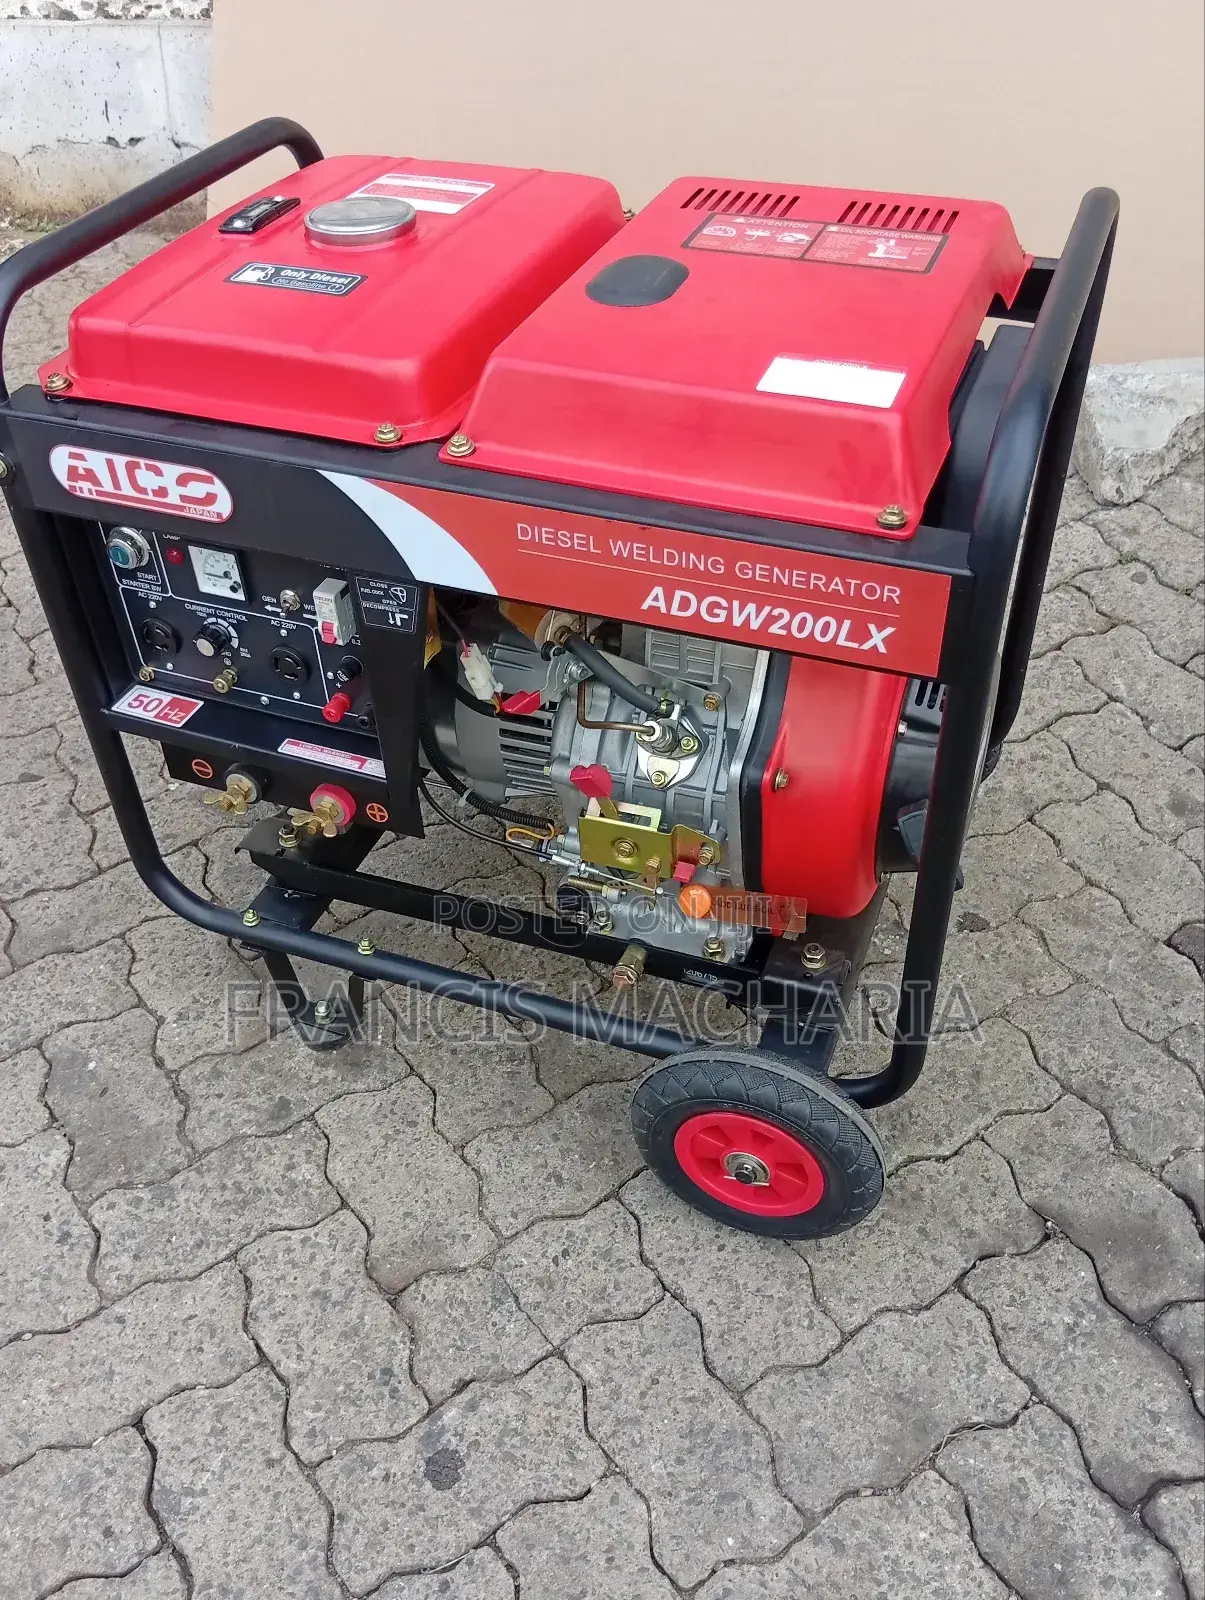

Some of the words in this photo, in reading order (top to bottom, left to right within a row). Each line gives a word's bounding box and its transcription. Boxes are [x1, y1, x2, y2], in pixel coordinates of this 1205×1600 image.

[746, 218, 810, 229] ATTENTION
[855, 229, 901, 239] SHORTAGE
[901, 233, 942, 243] WARNING
[280, 268, 310, 280] Only
[310, 271, 352, 285] Diesel
[290, 279, 327, 289] Gasoline
[183, 506, 218, 518] JAPAN
[517, 523, 602, 554] DIESEL
[609, 538, 726, 574] WELDING
[734, 561, 902, 605] GENERATOR
[136, 572, 157, 582] START
[121, 578, 150, 590] STARTER
[261, 595, 277, 604] GEN
[184, 603, 215, 615] CURRENT
[216, 609, 248, 622] CONTROL
[270, 619, 281, 627] AC
[281, 621, 297, 630] 220V
[640, 586, 897, 655] ADGW200LX
[336, 670, 350, 682] FUSE
[127, 693, 161, 713] 50
[160, 705, 187, 723] Hz
